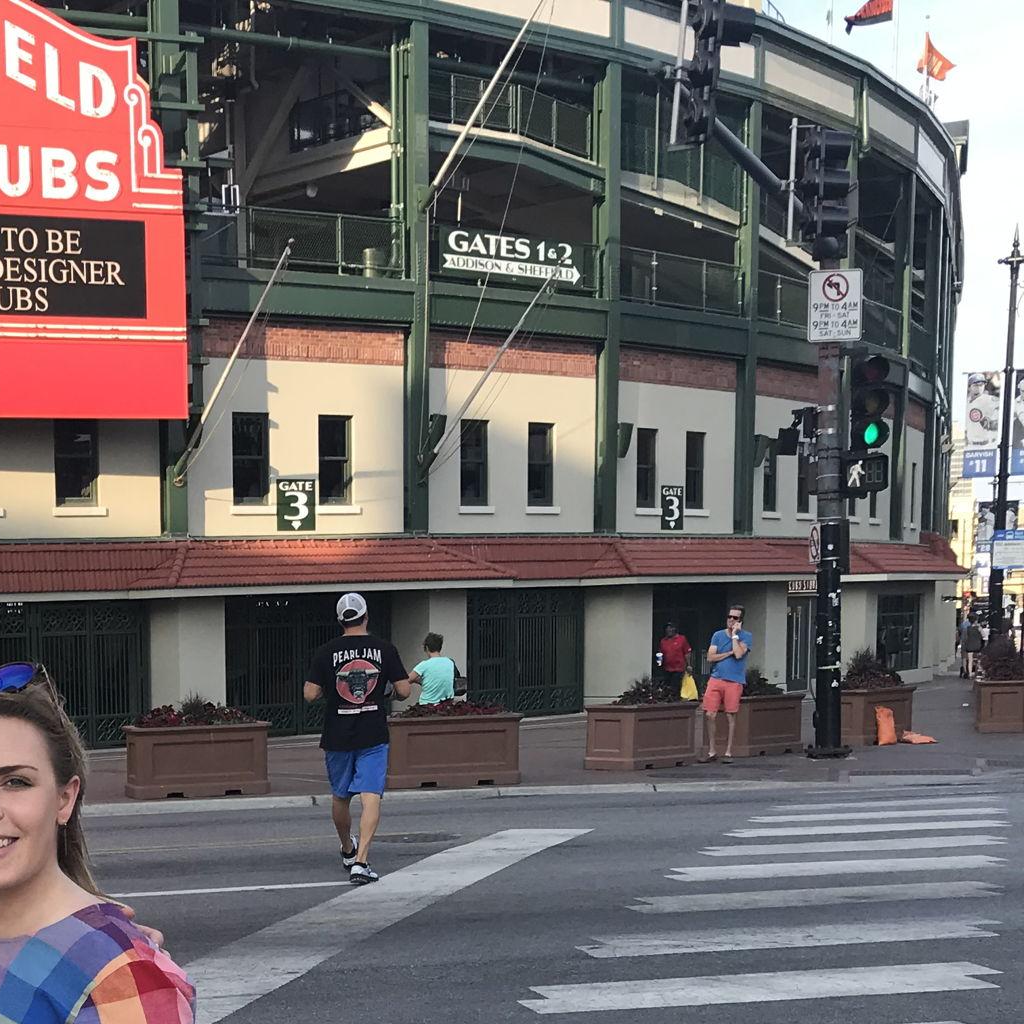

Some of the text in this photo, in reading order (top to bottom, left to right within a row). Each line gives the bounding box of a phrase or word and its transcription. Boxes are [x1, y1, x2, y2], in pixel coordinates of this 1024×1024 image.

[1, 227, 38, 254] TO
[45, 229, 82, 255] BE
[448, 230, 531, 259] GATES
[449, 257, 503, 272] ADDISON
[505, 262, 514, 273] &
[278, 481, 314, 491] GATE
[662, 487, 683, 496] GATE
[283, 491, 309, 520] 3
[665, 496, 680, 520] 3
[333, 647, 382, 667] PEARL JAM
